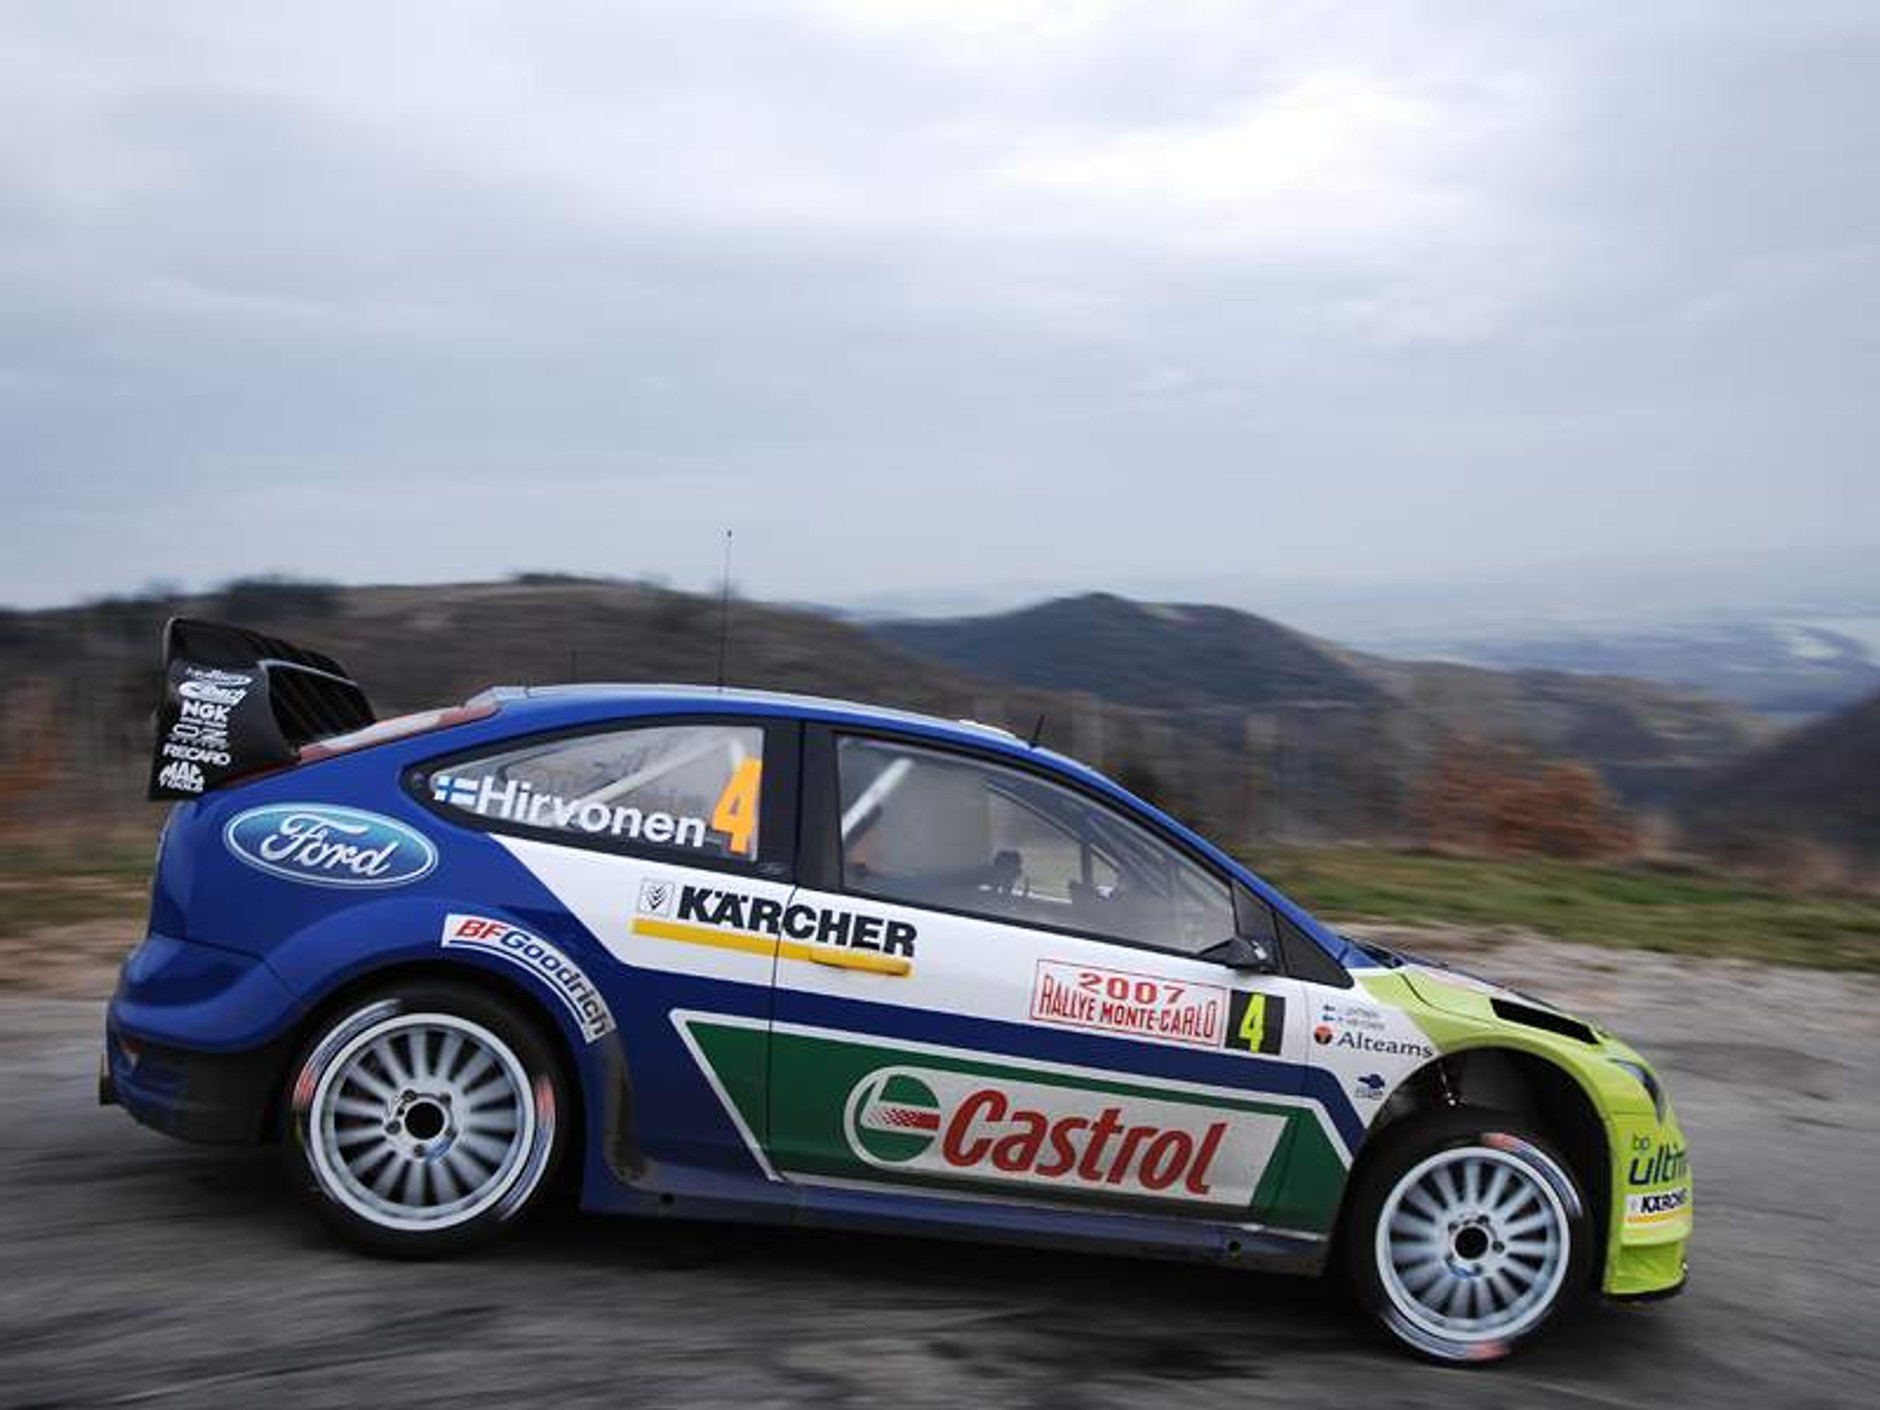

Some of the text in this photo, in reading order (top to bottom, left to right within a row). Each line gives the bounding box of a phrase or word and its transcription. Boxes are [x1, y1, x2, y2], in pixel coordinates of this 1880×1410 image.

[180, 699, 231, 722] NGK
[162, 743, 231, 766] RECARO
[475, 774, 707, 848] Hirvonen
[711, 757, 763, 854] 4
[260, 812, 399, 877] Ford
[677, 885, 918, 958] KÄRCHER
[456, 918, 608, 1036] BFGoodrich
[1038, 974, 1217, 1038] RALLYE MONTE-CARLO
[1078, 972, 1187, 1005] 2007
[1238, 992, 1267, 1055] 4
[1336, 1031, 1434, 1058] Alteams
[942, 1088, 1228, 1195] Castrol
